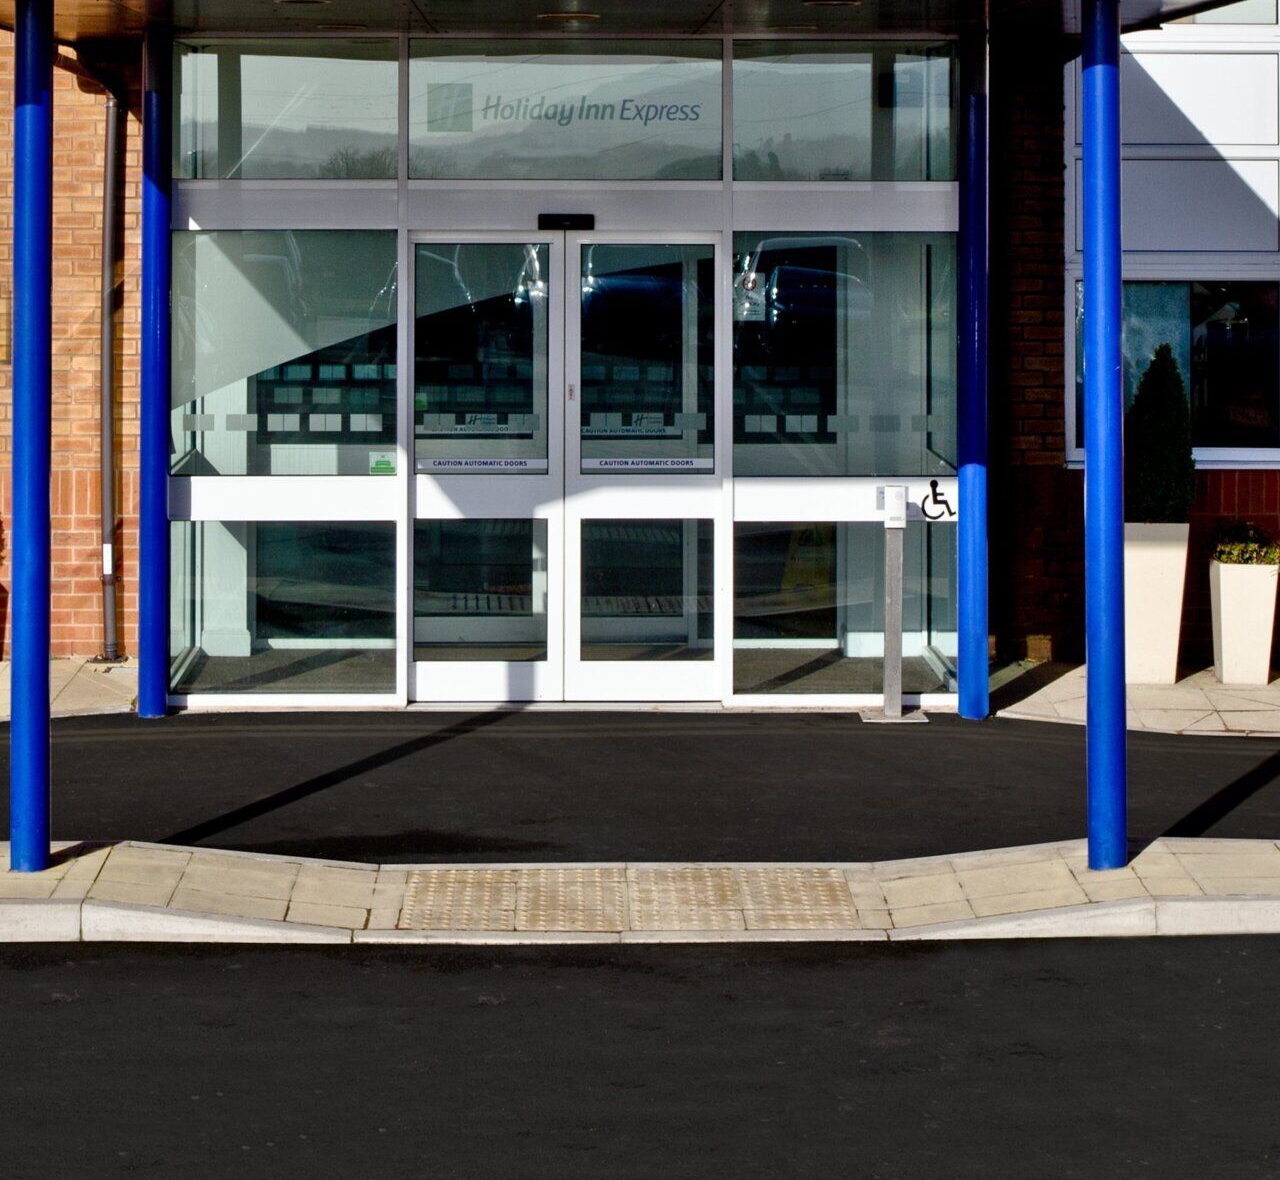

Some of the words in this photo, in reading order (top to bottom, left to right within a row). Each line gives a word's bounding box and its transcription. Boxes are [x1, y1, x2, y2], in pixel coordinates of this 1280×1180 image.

[482, 95, 574, 126] Holiday
[578, 96, 615, 121] Inn
[620, 99, 701, 126] Express
